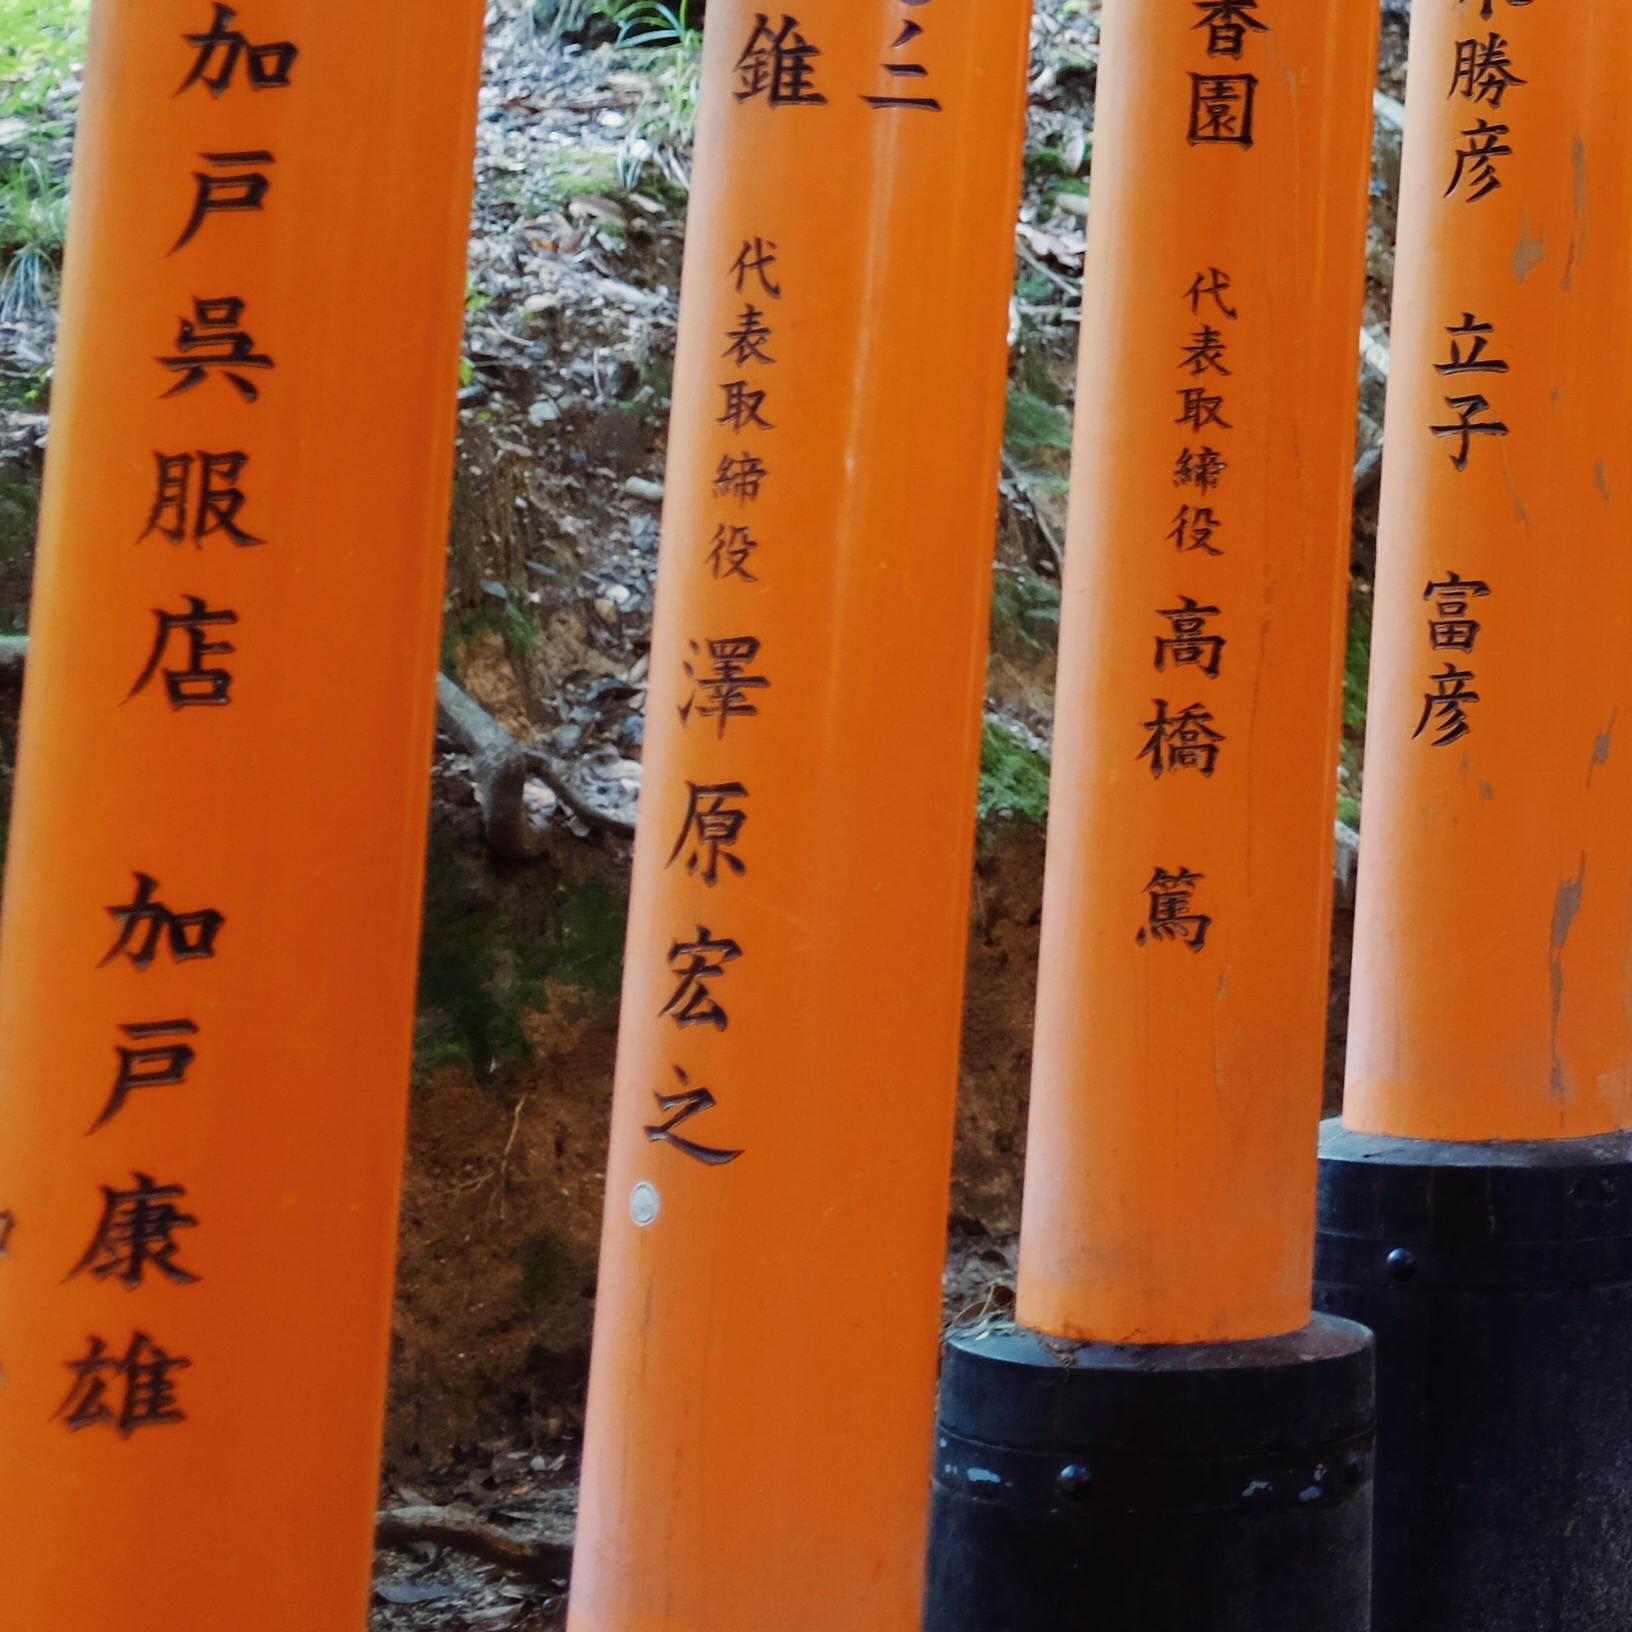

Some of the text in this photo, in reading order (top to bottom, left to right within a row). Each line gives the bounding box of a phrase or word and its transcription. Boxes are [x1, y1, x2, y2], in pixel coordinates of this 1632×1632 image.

[119, 1, 299, 712] 加戸呉服店
[704, 236, 782, 584] 代表取締役
[1165, 265, 1239, 558] 代表取締役
[1429, 312, 1509, 472] 立子
[1411, 571, 1490, 747] 富彦
[643, 634, 772, 1166] 澤原宏之
[49, 870, 227, 1442] 加戸康雄
